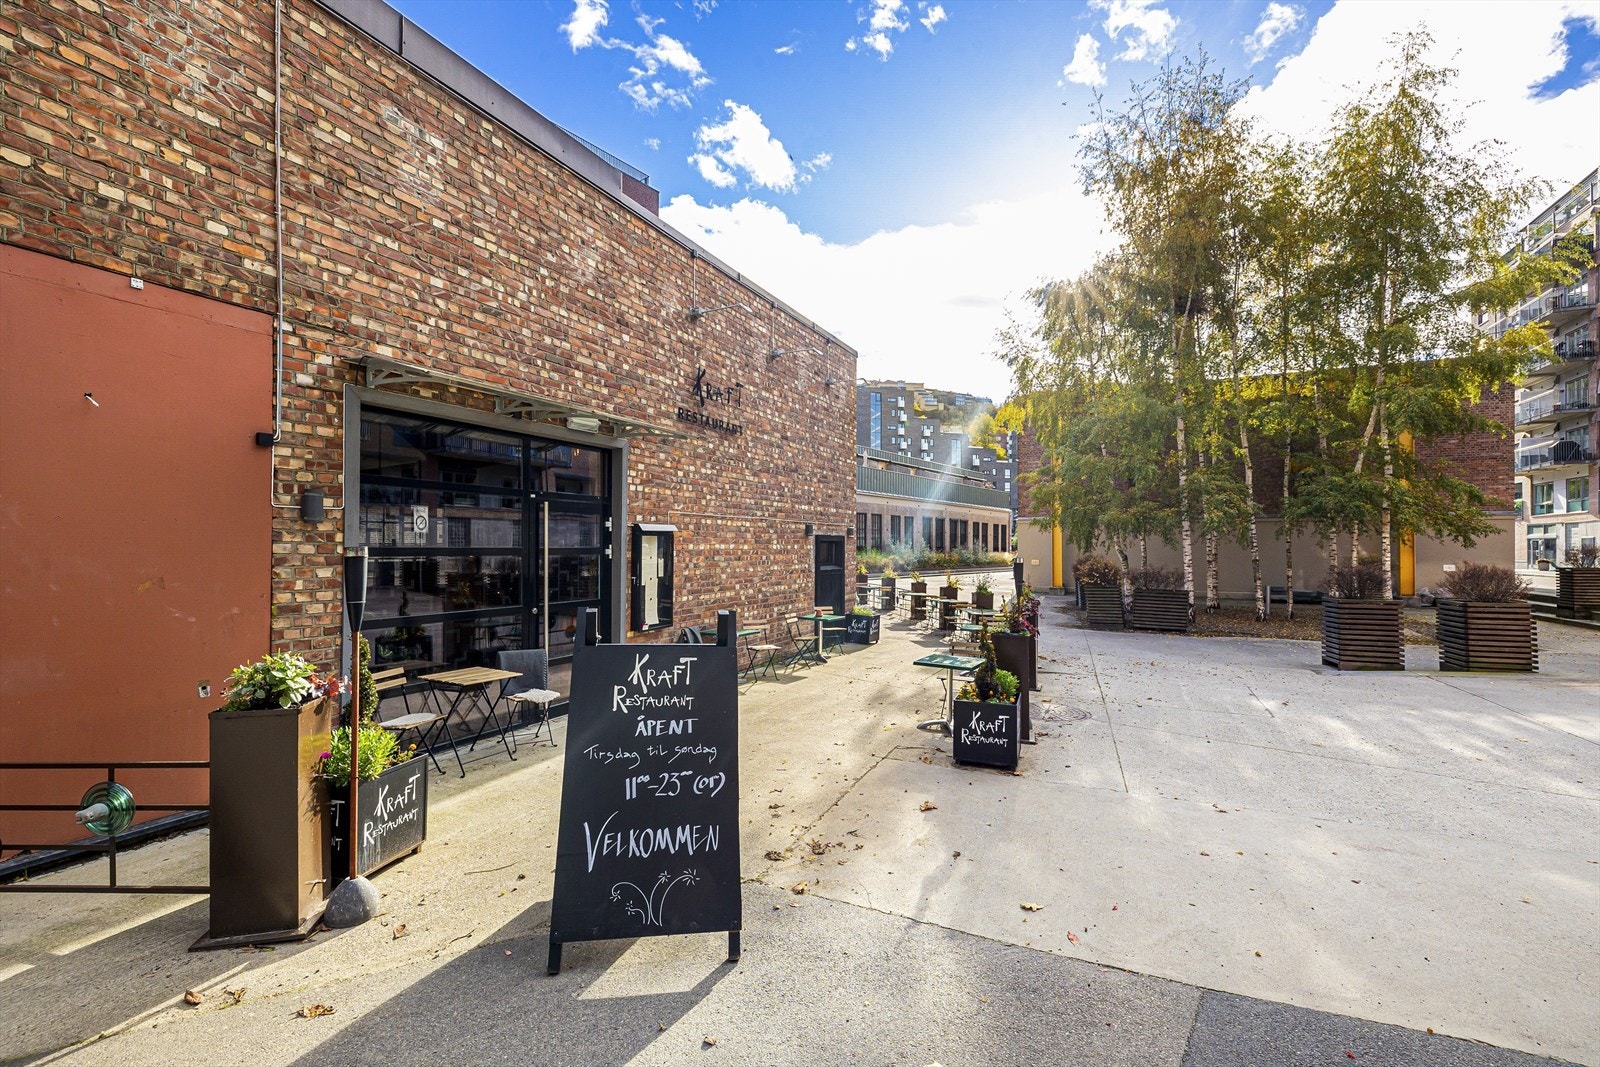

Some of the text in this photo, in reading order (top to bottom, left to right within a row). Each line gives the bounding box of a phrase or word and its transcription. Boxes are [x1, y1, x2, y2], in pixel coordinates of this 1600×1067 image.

[677, 407, 743, 436] RESTAURANT
[628, 653, 698, 694] KRAFT
[612, 684, 694, 713] RESTAURANT
[634, 715, 699, 737] ÅPENT
[968, 711, 1010, 735] KRAFT
[583, 743, 641, 769] Tirsdag
[373, 773, 421, 822] KRAFT
[363, 808, 419, 848] RESTAURANT
[583, 810, 719, 873] VELKOMMEN
